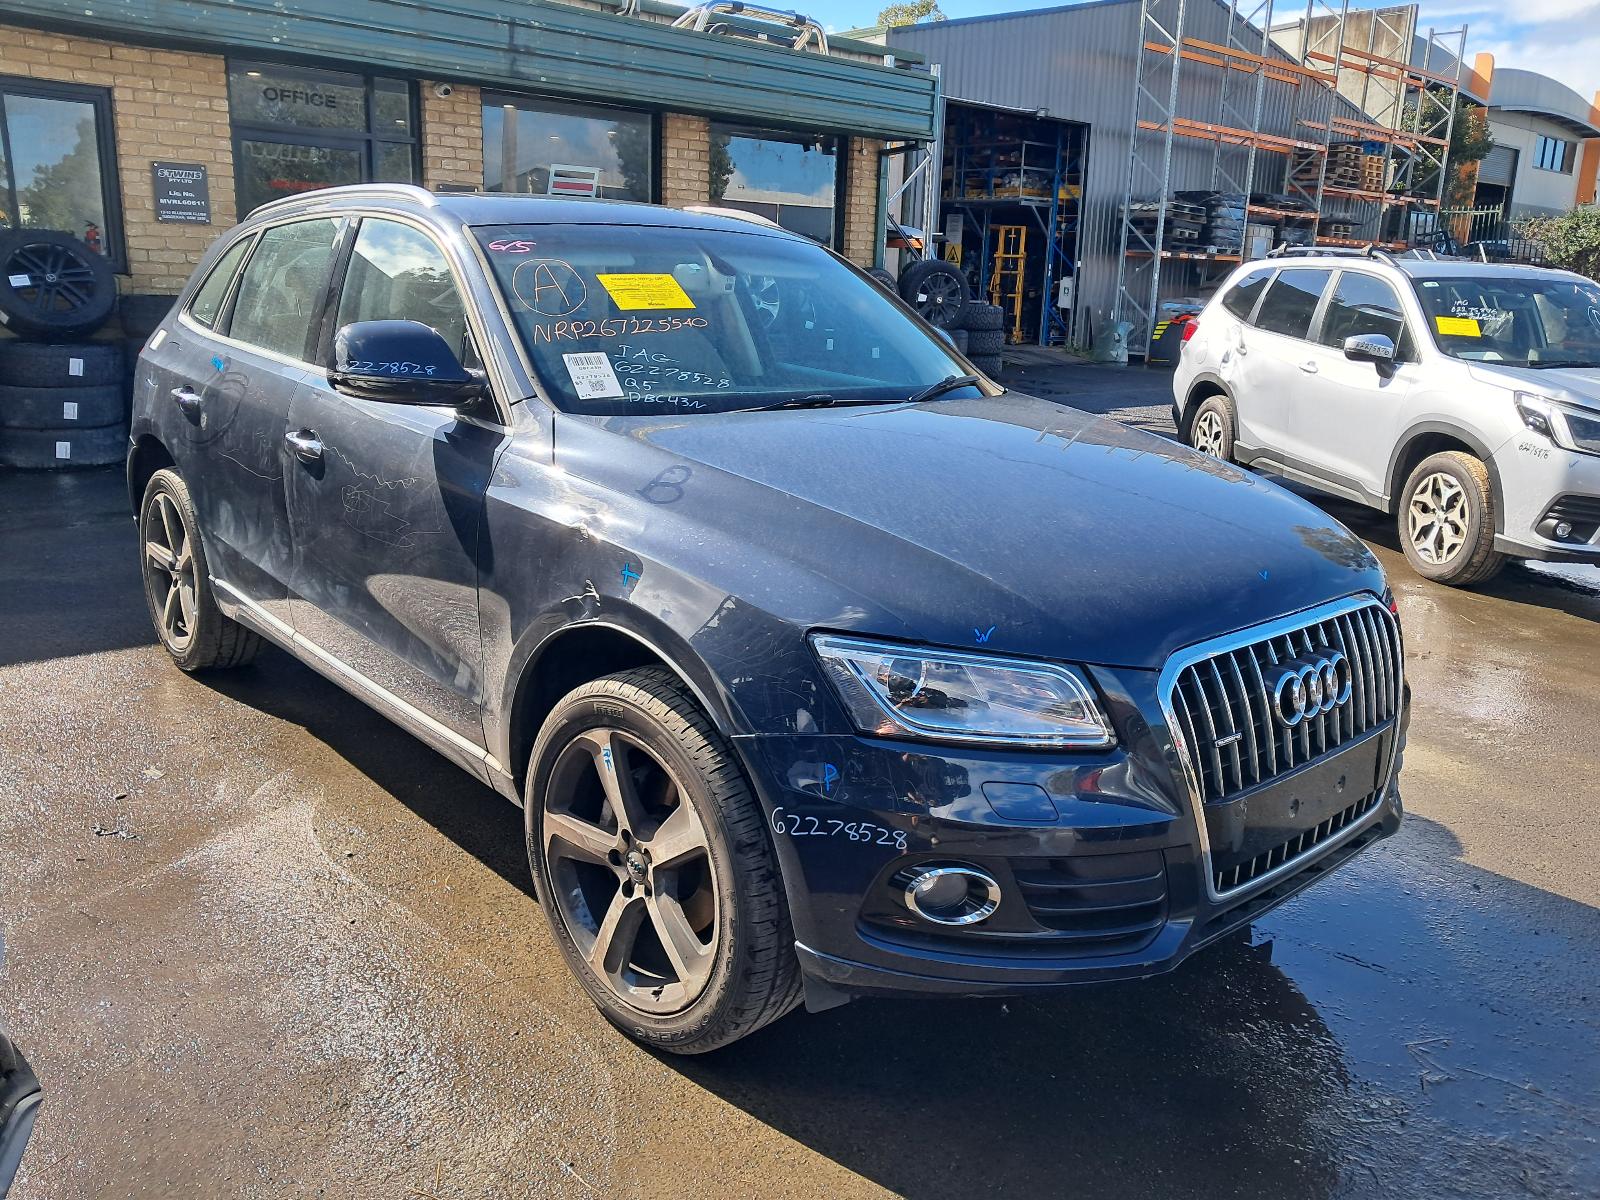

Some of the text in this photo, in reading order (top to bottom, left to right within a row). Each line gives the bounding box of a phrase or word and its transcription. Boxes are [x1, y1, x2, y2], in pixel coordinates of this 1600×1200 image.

[263, 87, 337, 109] OFFICE
[534, 262, 570, 307] A
[614, 361, 731, 388] 62278528
[624, 378, 659, 391] Q5
[823, 761, 839, 792] P
[771, 806, 907, 850] 62278528
